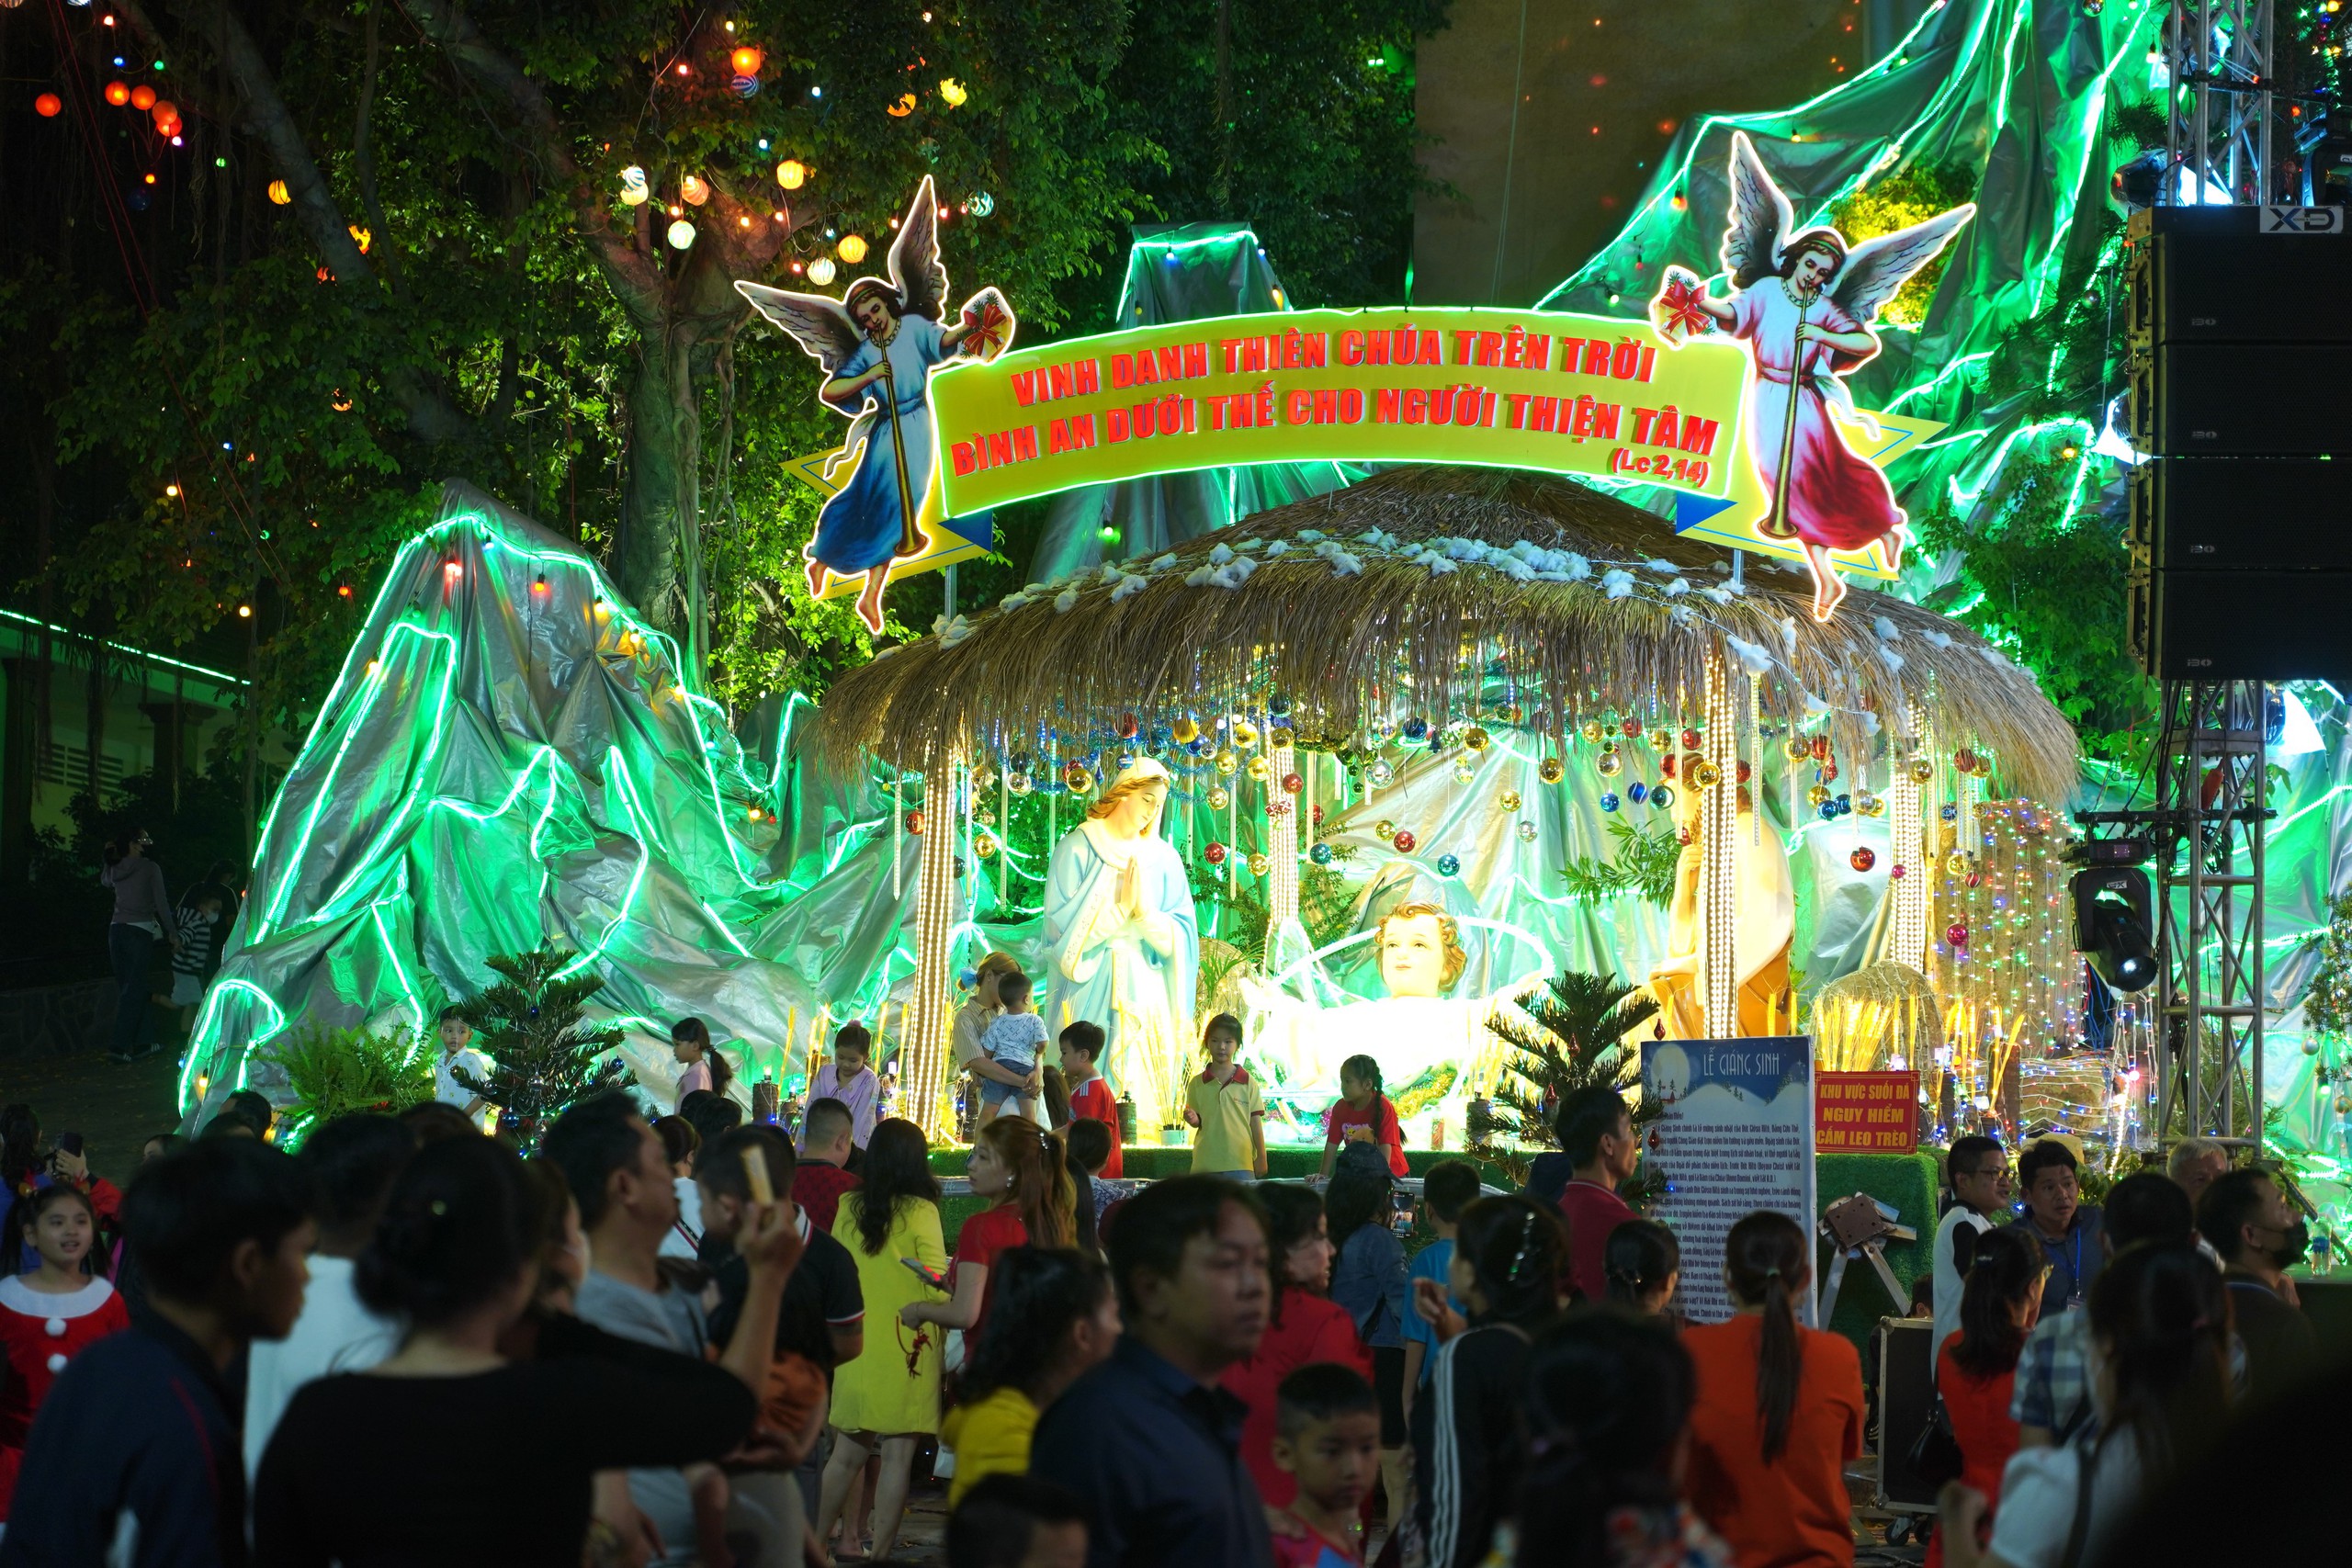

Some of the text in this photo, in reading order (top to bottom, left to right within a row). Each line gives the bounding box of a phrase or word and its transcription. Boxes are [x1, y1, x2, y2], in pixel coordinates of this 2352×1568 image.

[1011, 323, 1657, 407] VINH DANH THIÊN CHÚA TRÊN TRỜI
[951, 379, 1721, 478] BÌNH AN DƯỚI THẾ CHO NGƯỜI THIỆN TÂM
[1704, 1045, 1780, 1076] LỄ GIÁNG SINH
[1820, 1084, 1842, 1100] KHU
[1845, 1082, 1866, 1102] VỰC
[1868, 1080, 1894, 1100] SUỐI
[1823, 1103, 1905, 1123] NGUY HIỂM
[1815, 1125, 1908, 1147] CẤM LEO TRÈO
